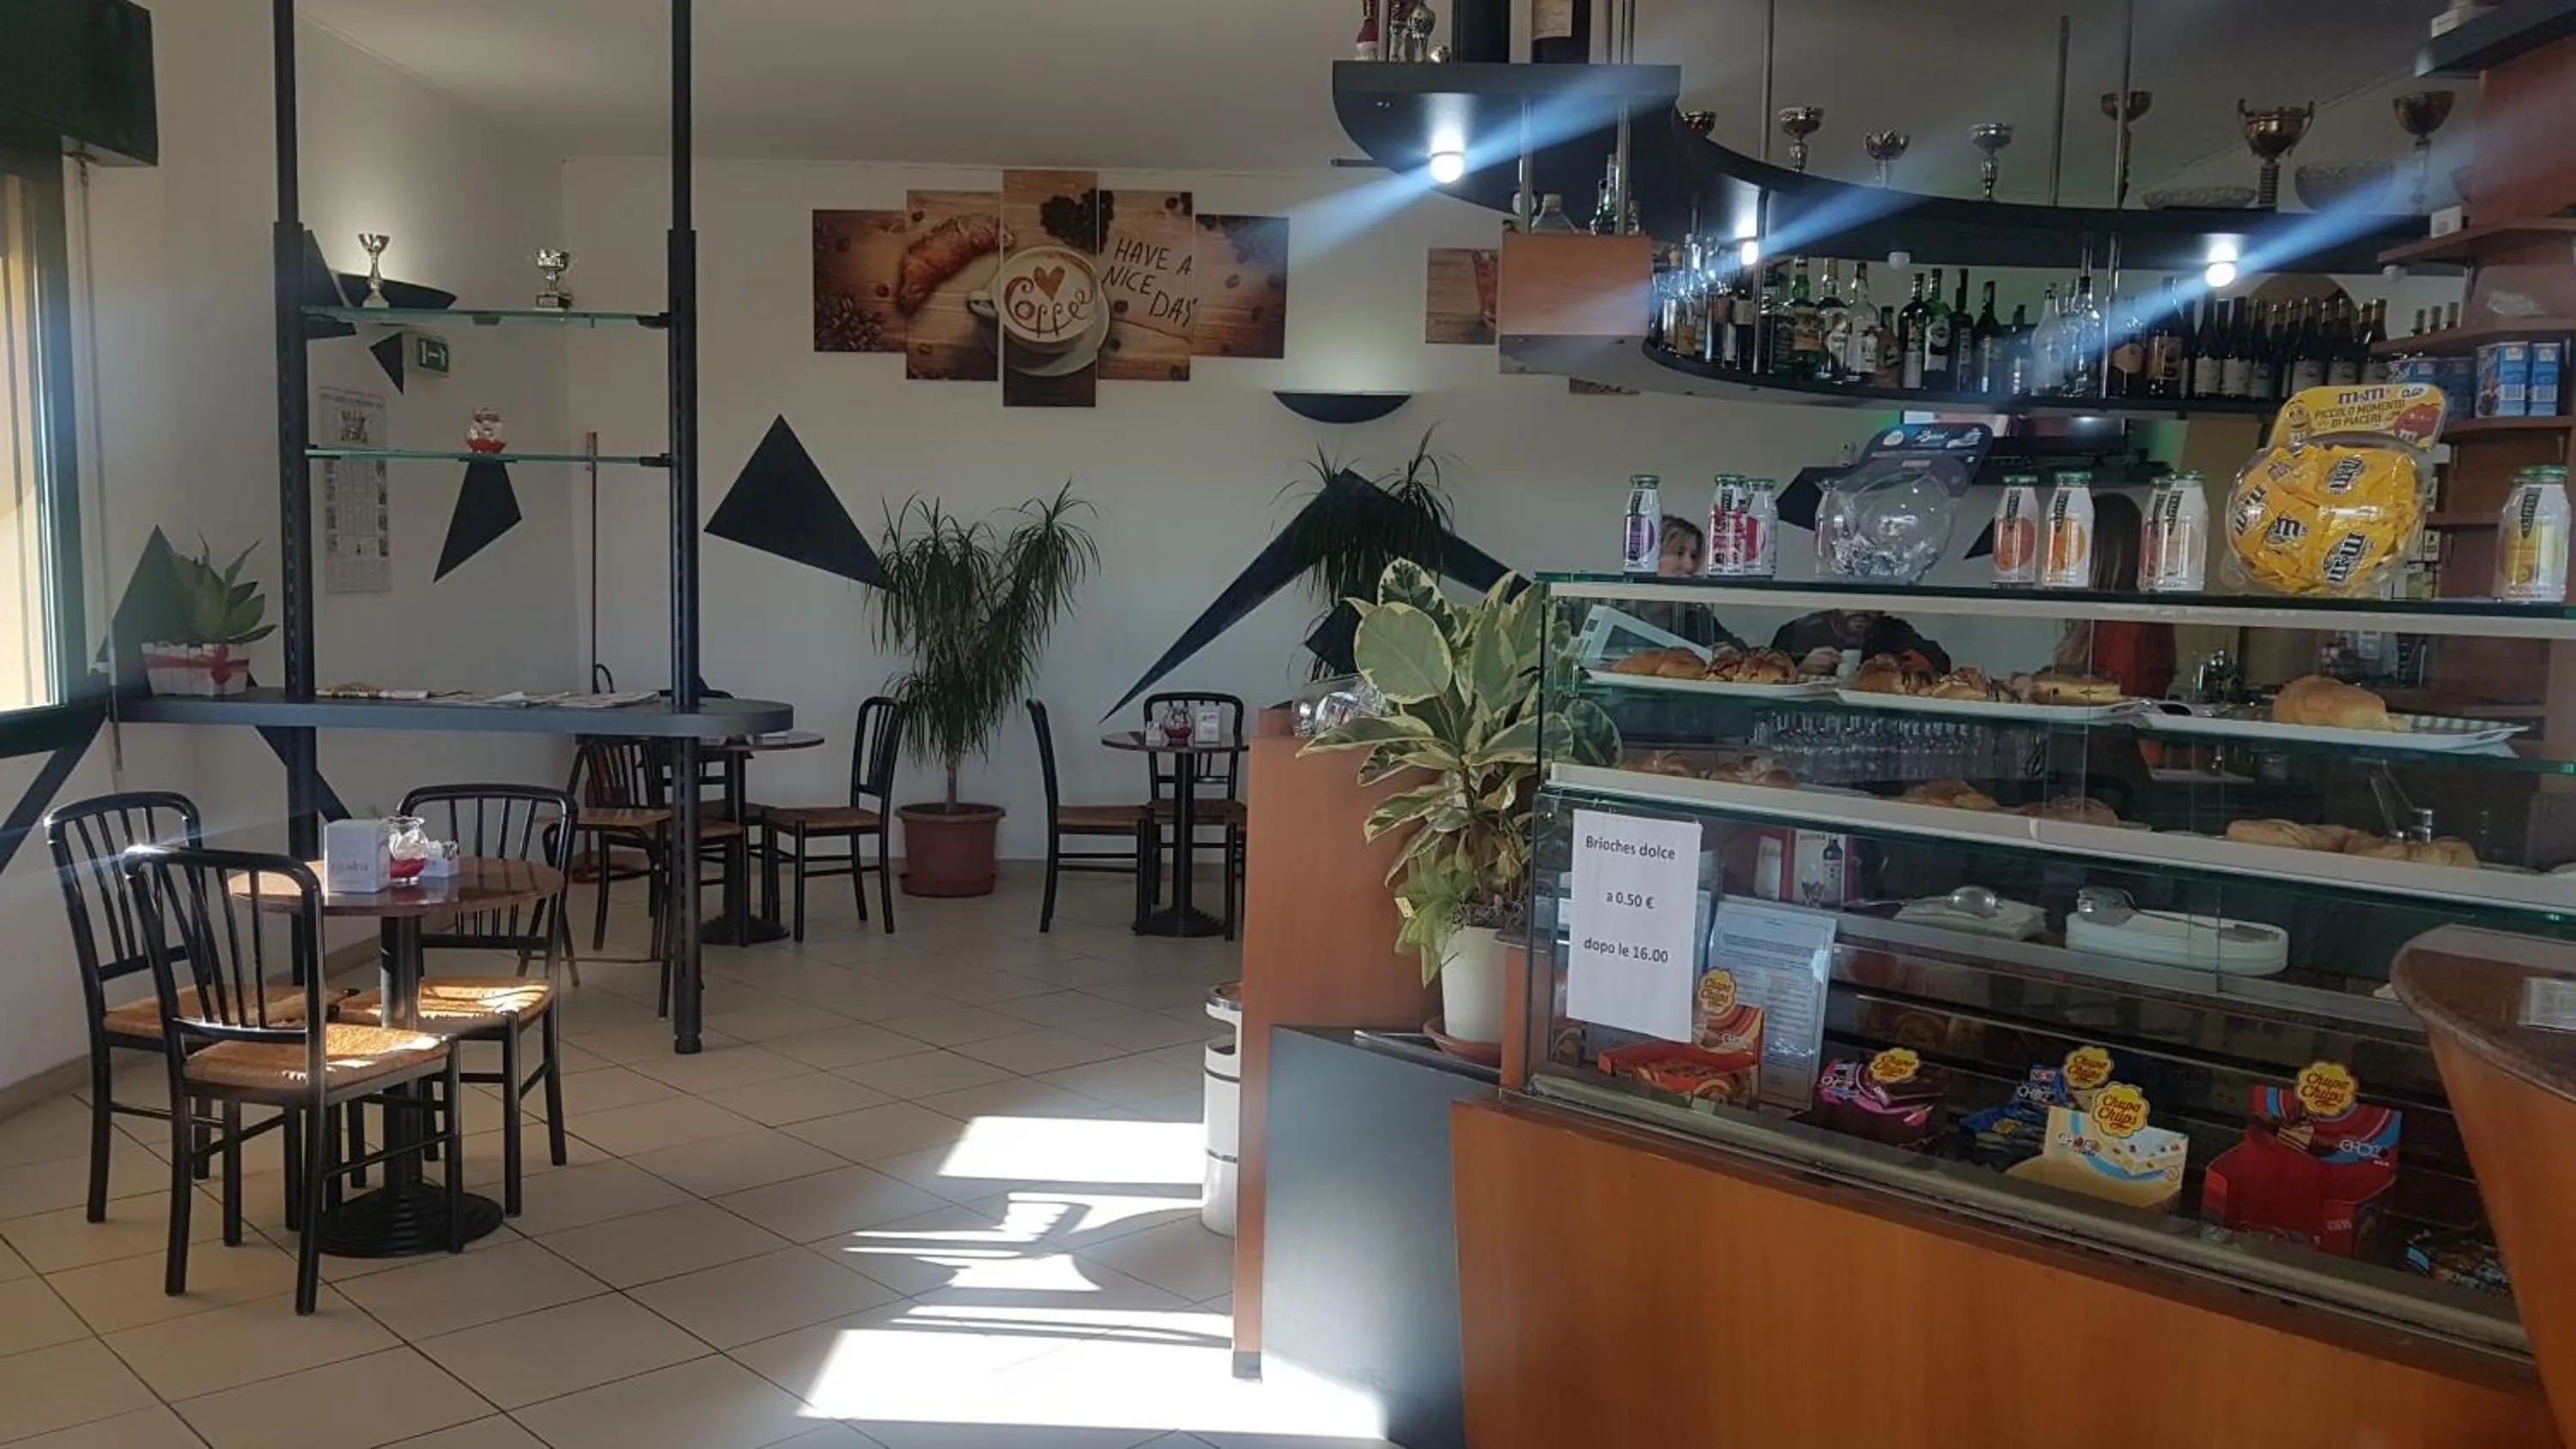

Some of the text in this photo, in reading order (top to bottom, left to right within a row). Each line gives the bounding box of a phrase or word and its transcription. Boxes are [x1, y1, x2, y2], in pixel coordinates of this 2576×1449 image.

[1114, 237, 1193, 276] HAVE A
[1102, 265, 1155, 295] NICE
[1148, 290, 1198, 327] DAY
[1586, 835, 1675, 860] Brioches dolce
[1607, 892, 1656, 909] a 0.50 €
[1583, 937, 1668, 964] dopo le 16.00
[2104, 1095, 2143, 1114] Chupa
[2098, 1107, 2137, 1129] Chups
